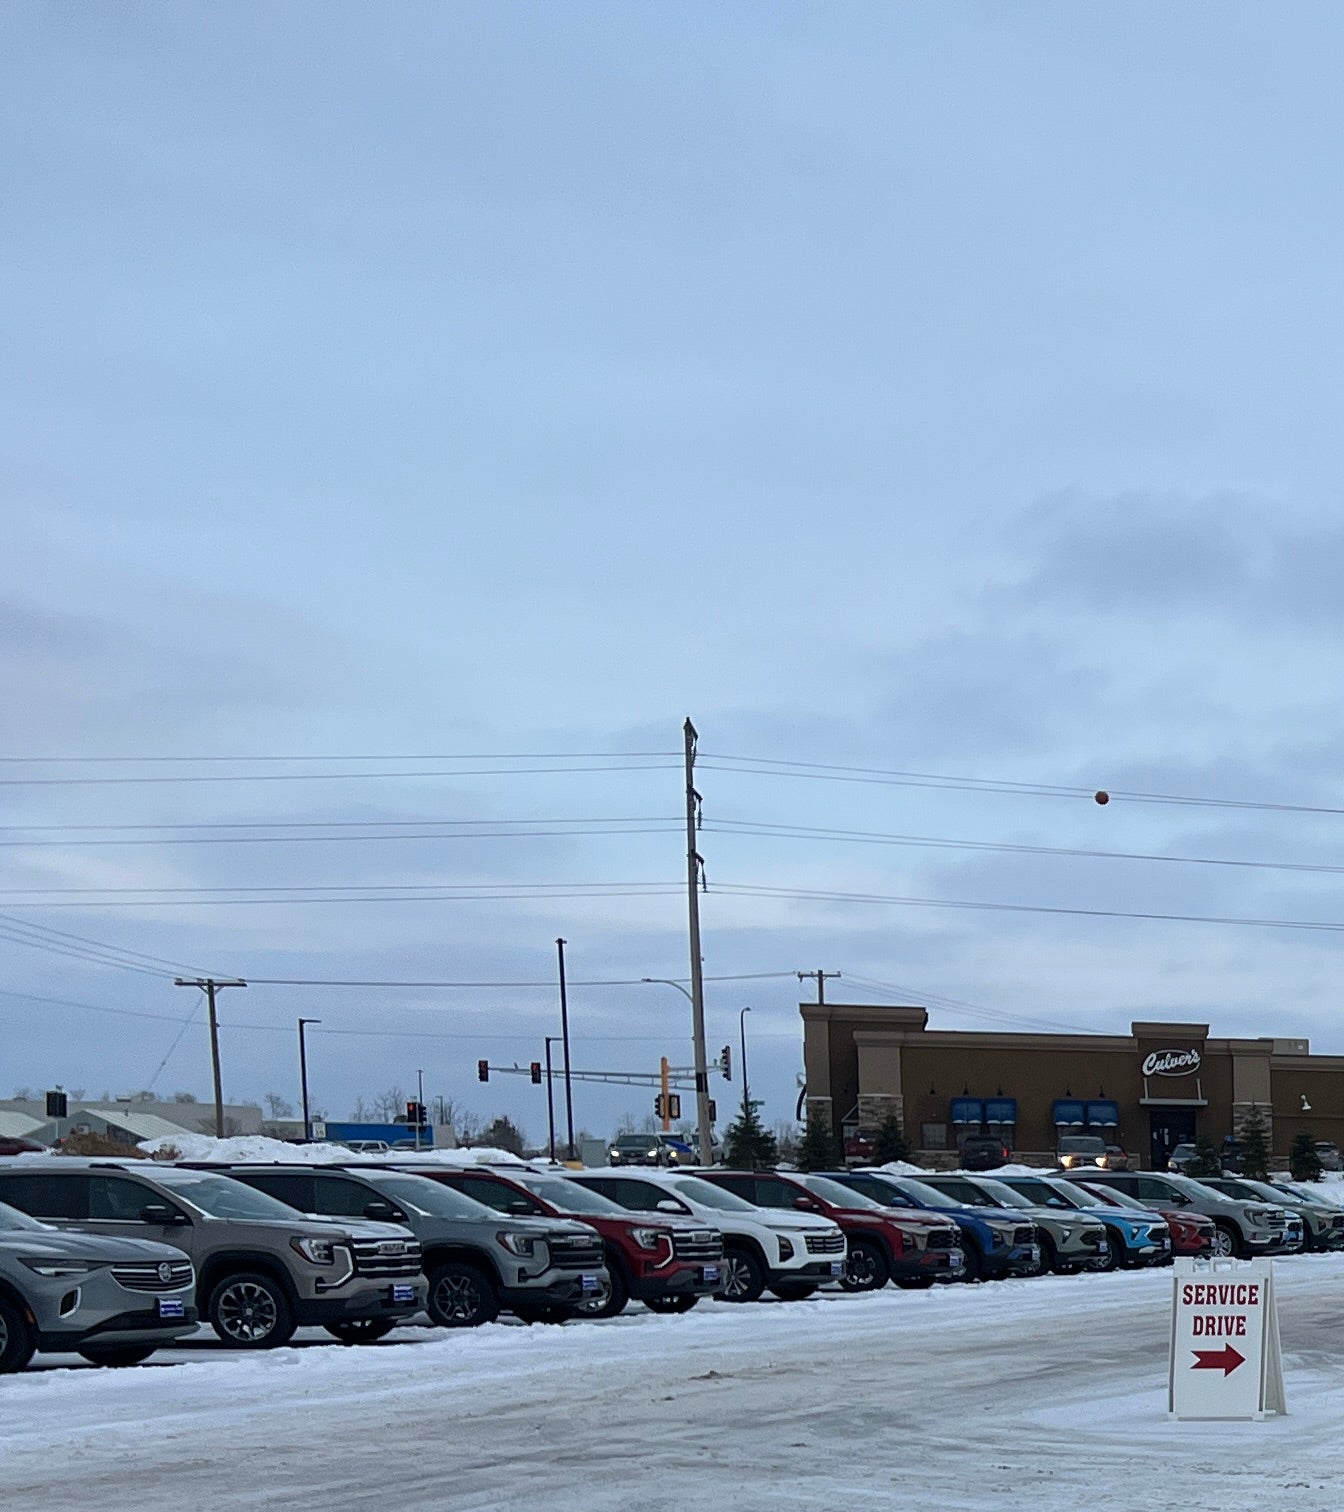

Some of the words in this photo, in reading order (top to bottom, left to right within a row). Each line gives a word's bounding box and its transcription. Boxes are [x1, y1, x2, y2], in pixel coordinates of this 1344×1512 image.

[1142, 1049, 1201, 1076] Culver's
[1182, 1284, 1259, 1306] SERVICE
[1192, 1315, 1247, 1336] DRIVE
